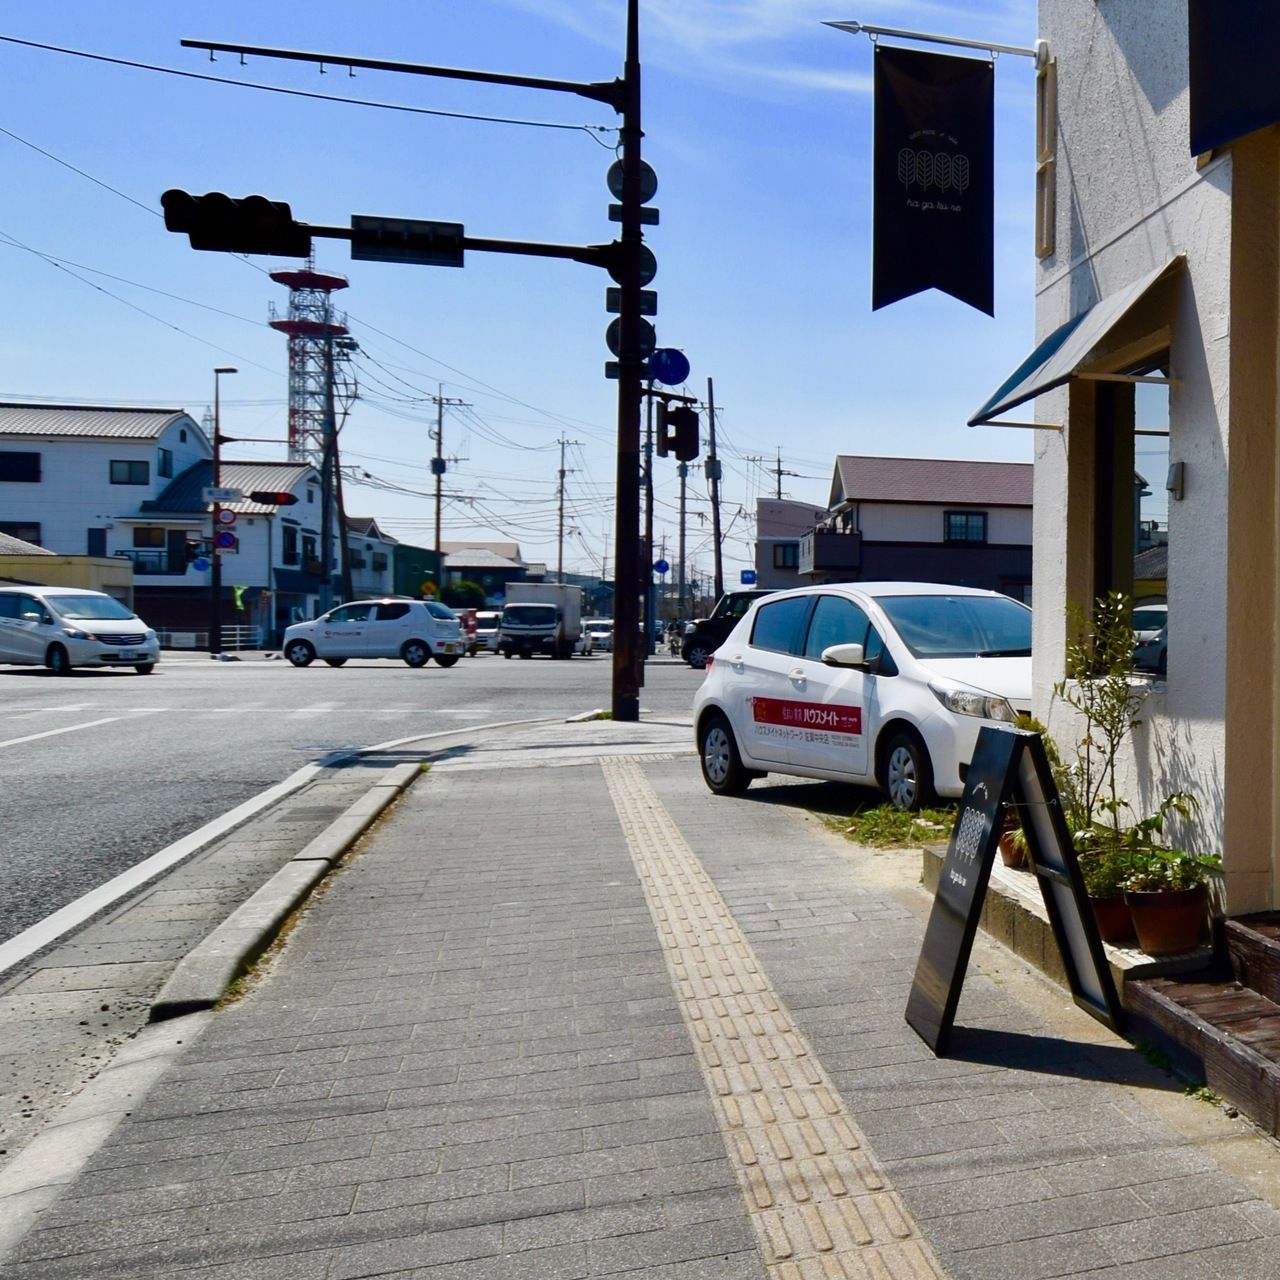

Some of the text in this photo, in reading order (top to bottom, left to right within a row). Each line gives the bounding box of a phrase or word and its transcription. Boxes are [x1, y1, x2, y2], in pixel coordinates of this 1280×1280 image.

[803, 708, 840, 725] ハウスメイト
